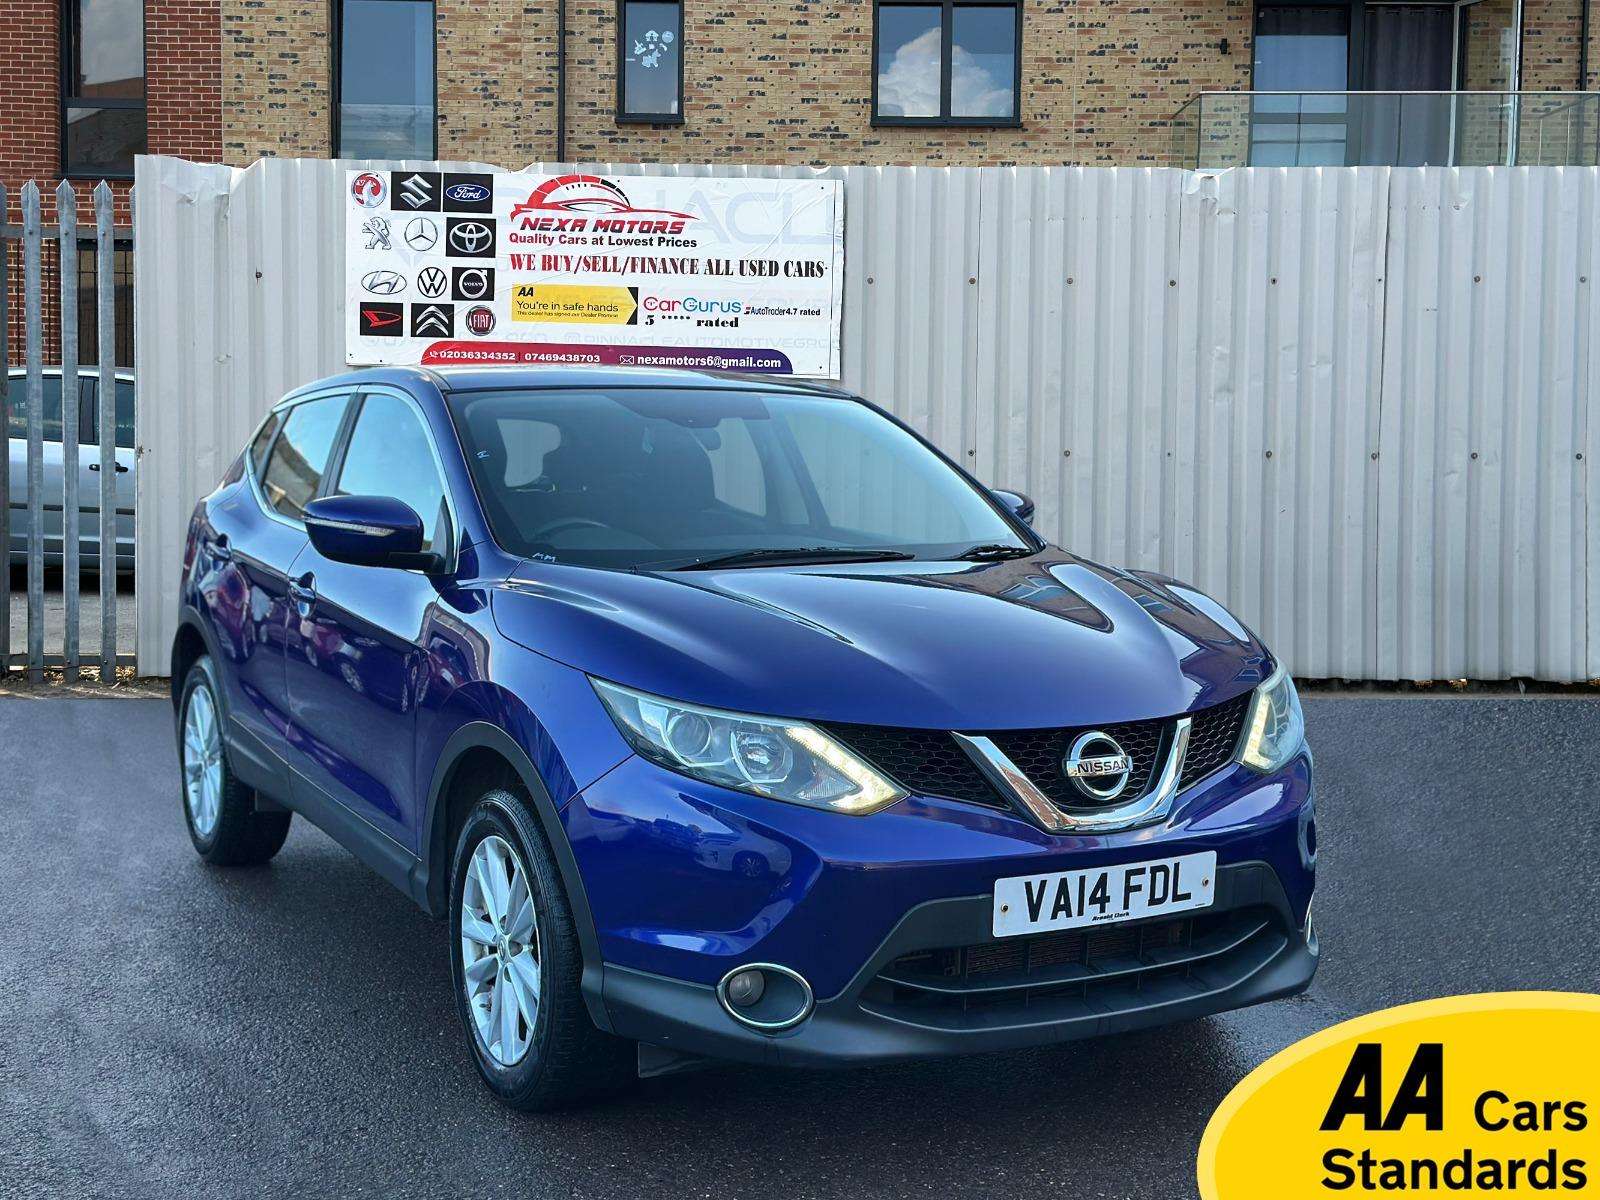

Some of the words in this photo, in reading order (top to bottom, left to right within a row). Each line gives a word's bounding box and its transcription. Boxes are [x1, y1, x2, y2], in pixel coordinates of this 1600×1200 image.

[454, 187, 481, 199] Ford
[520, 217, 587, 232] NEXA
[592, 219, 686, 234] MOTORS
[509, 232, 554, 246] Quality
[558, 234, 587, 245] Cars
[591, 235, 604, 246] at
[608, 235, 654, 247] Lowest
[657, 236, 697, 247] Prices
[510, 253, 536, 270] WE
[541, 255, 699, 275] BUY/SELL/FINANCE
[704, 258, 734, 276] ALL
[739, 259, 780, 277] USED
[784, 260, 824, 278] CARS
[518, 286, 534, 297] AA
[517, 300, 549, 310] You're
[551, 301, 560, 310] in
[563, 302, 585, 311] safe
[587, 303, 618, 312] hands
[643, 296, 741, 313] CarGurus
[799, 308, 821, 316] rated
[473, 314, 490, 328] FIAT
[645, 315, 655, 325] 5
[696, 317, 739, 328] rated
[440, 351, 516, 361] 02036334352
[524, 353, 601, 363] 07469438703
[637, 355, 781, 368] nexamotors6@gmail.com
[1077, 760, 1130, 774] NISSAN
[1024, 871, 1111, 923] VA14
[1122, 862, 1192, 911] FDL
